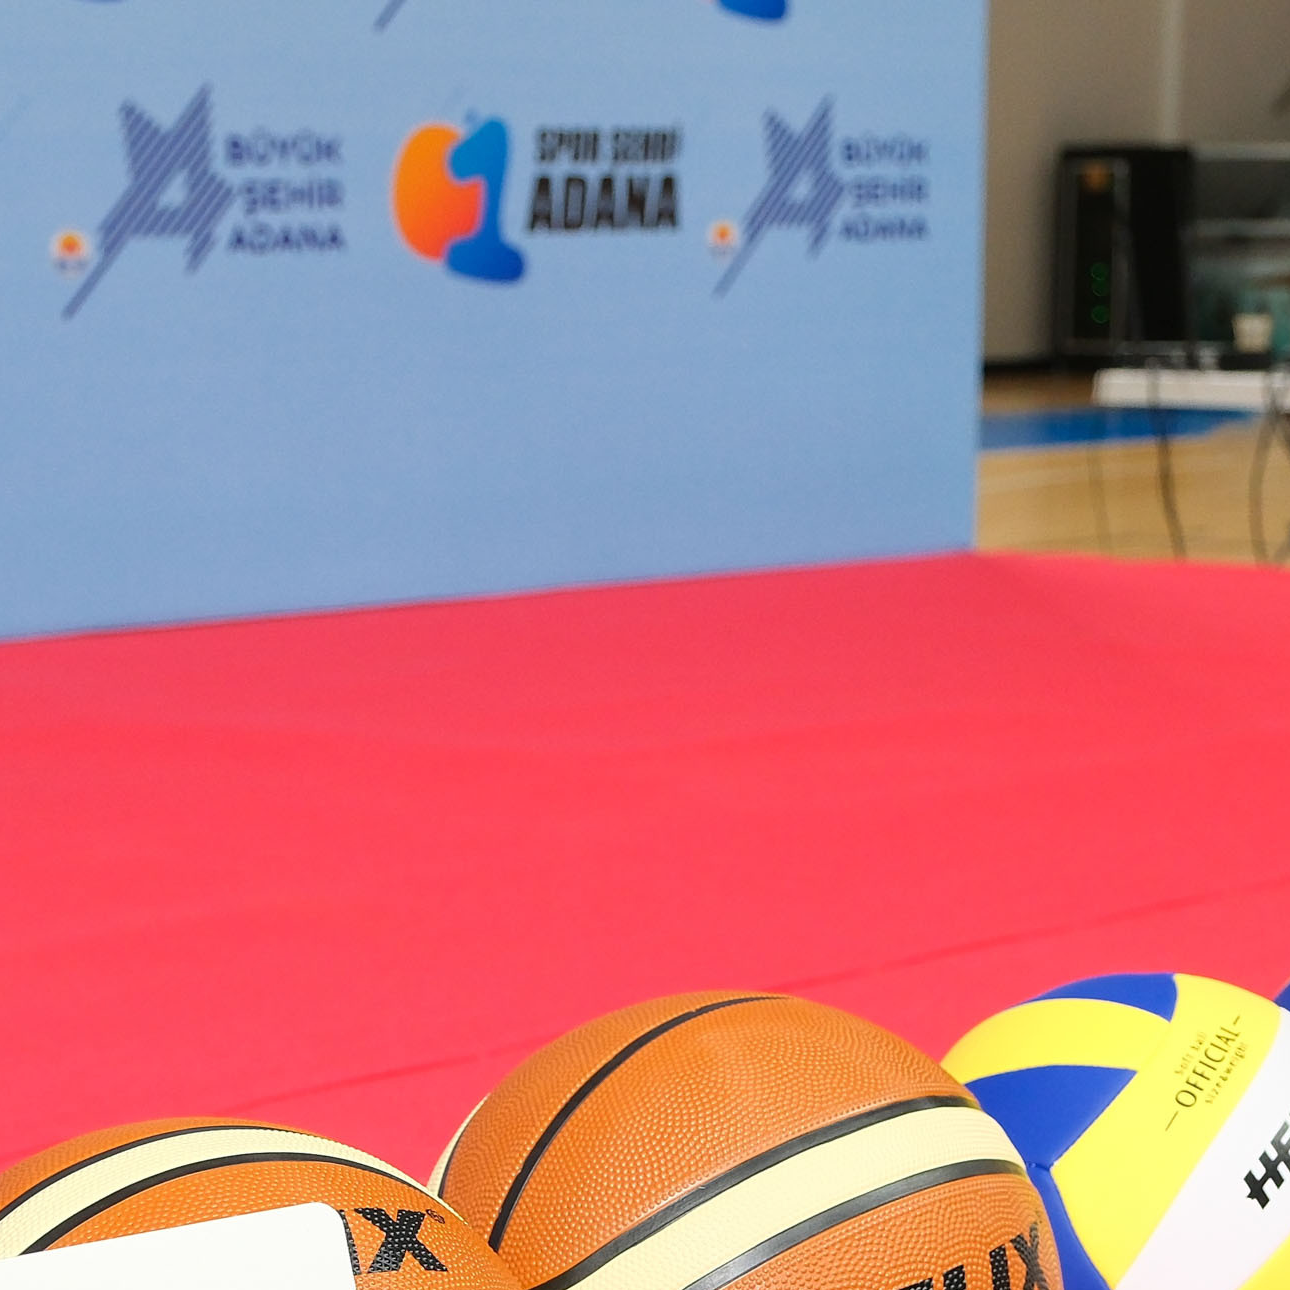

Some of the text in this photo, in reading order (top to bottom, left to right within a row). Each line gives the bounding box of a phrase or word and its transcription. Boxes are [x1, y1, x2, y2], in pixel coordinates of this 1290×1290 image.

[527, 174, 681, 231] ADANA
[228, 224, 345, 252] ADANA
[1174, 1026, 1241, 1108] OFFICIAL
